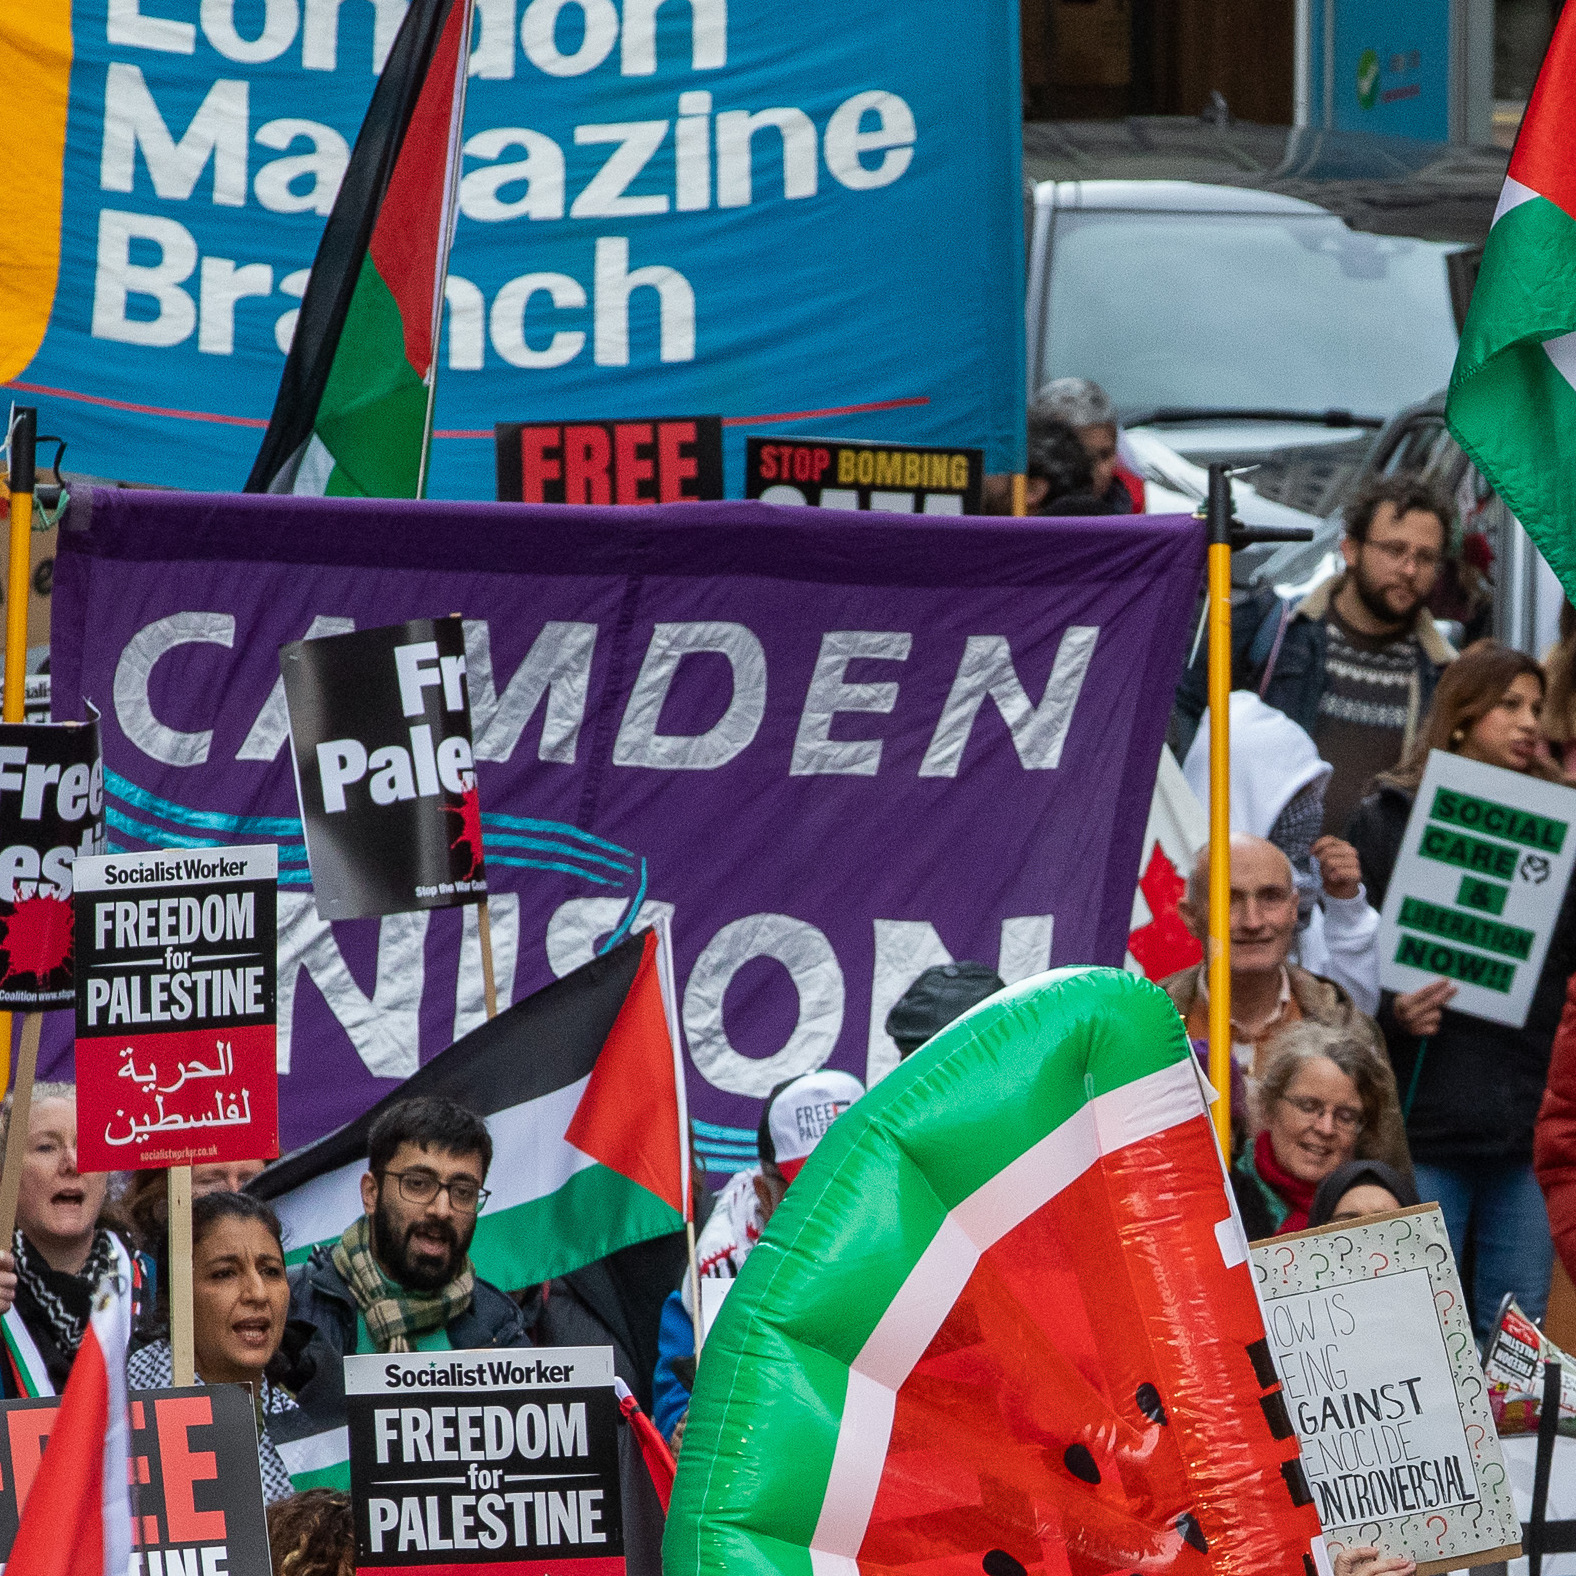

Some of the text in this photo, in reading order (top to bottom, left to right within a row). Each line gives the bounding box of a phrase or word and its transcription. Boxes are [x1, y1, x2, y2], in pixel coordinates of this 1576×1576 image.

[100, 62, 917, 223] Maazine
[521, 421, 698, 502] FREE
[759, 445, 969, 490] STOP BOMBING
[1437, 793, 1560, 848] SOCIAL
[1425, 832, 1515, 879] CARE
[95, 893, 255, 951] FREEDOM
[164, 947, 192, 971] for
[87, 967, 265, 1028] PALESTINE
[117, 1041, 235, 1094] الحرية
[104, 1089, 251, 1147] لفلسطين
[795, 1102, 834, 1124] FREE
[1327, 1291, 1355, 1336] IS
[1277, 1342, 1349, 1399] EING
[374, 1402, 589, 1465] FREEDOM
[1297, 1375, 1422, 1437] GAINST
[466, 1462, 502, 1490] for
[1302, 1420, 1421, 1479] ENOCIDE
[1310, 1455, 1475, 1527] ONTROVERSIAL
[369, 1489, 607, 1553] PALESTINE
